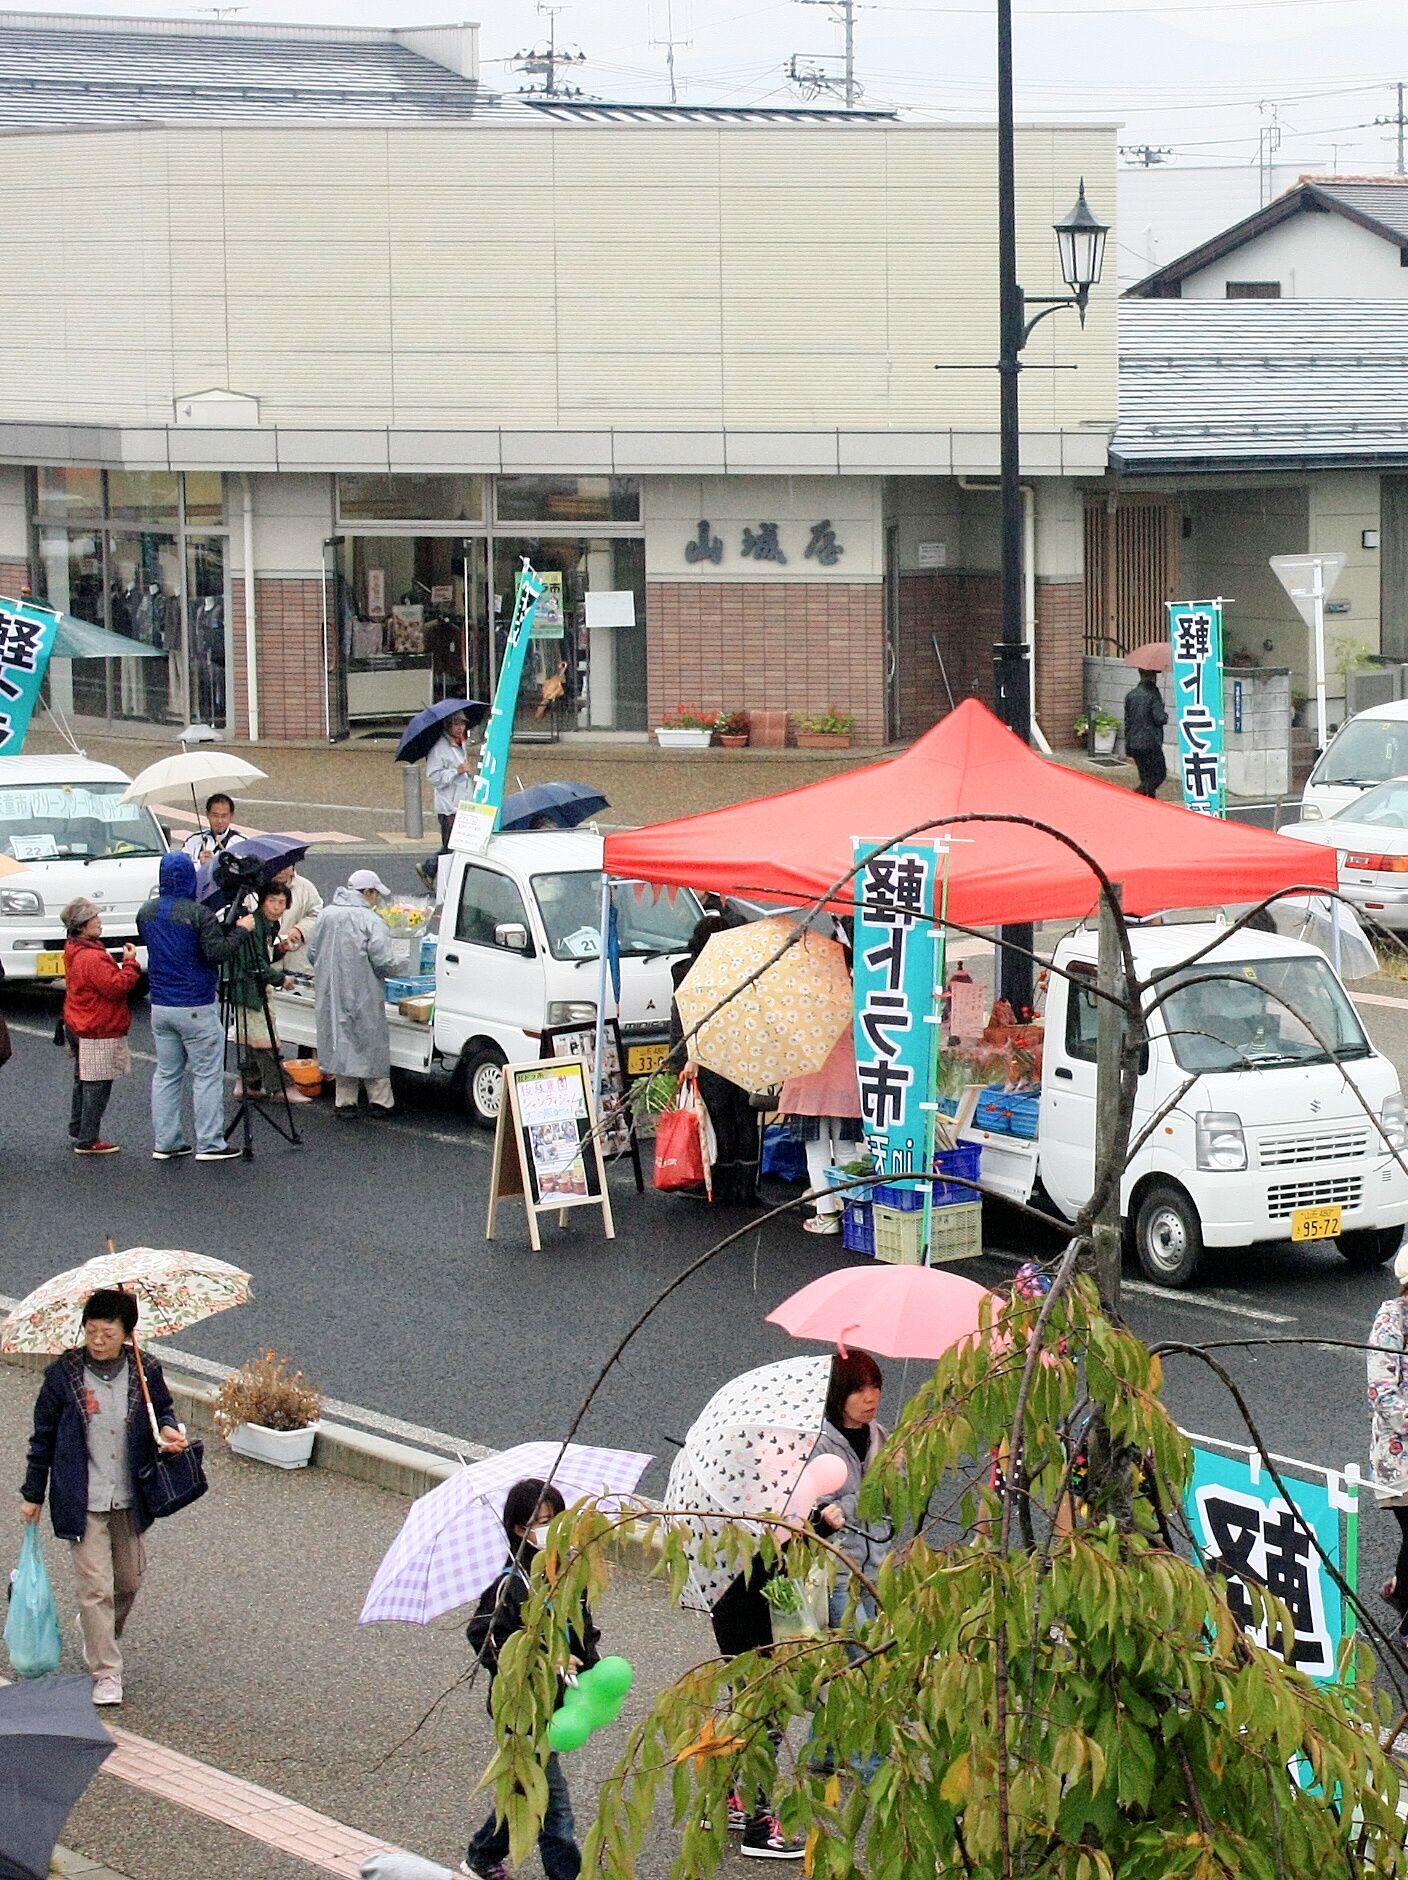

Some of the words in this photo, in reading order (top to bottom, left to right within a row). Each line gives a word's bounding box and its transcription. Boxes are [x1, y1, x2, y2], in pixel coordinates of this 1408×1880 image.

[25, 846, 42, 856] 22
[580, 939, 597, 951] 21
[1303, 1218, 1338, 1237] 95-72
